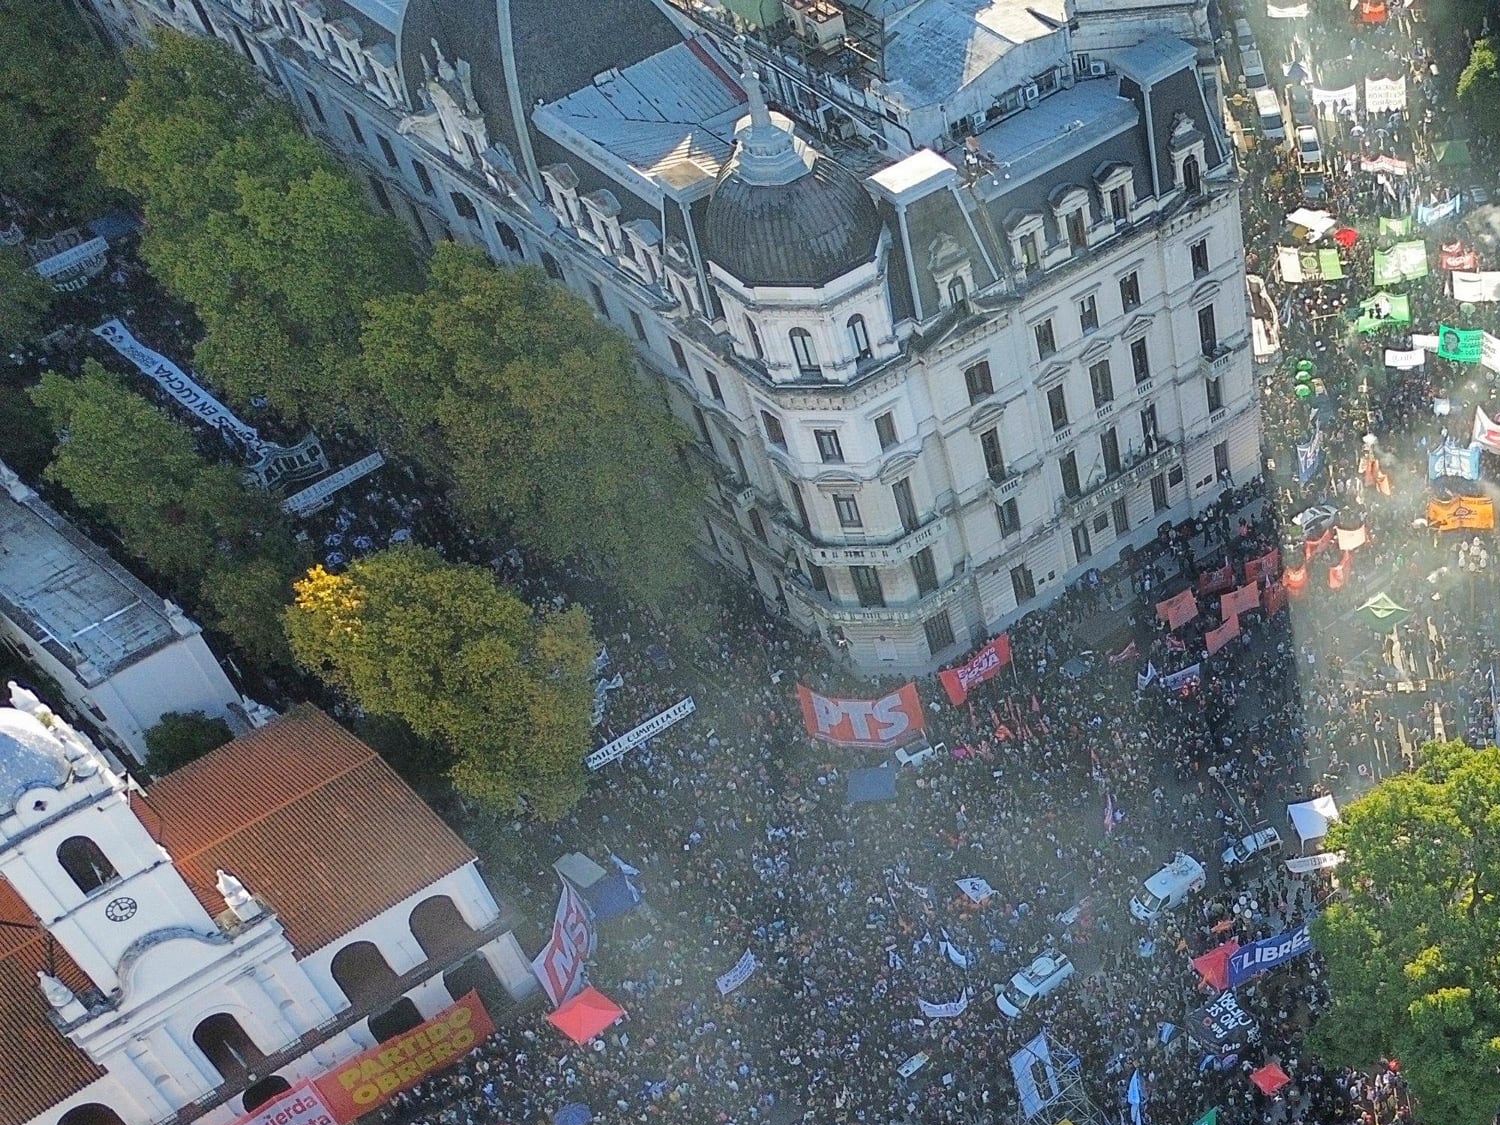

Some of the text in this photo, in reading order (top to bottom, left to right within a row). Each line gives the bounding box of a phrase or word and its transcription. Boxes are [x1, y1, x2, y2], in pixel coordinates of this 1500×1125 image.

[151, 362, 203, 406] LUCHA
[810, 691, 910, 741] PTS
[1205, 1000, 1239, 1032] NO SE
[338, 1006, 471, 1091] PARTIDO
[352, 1029, 475, 1106] OBRERO
